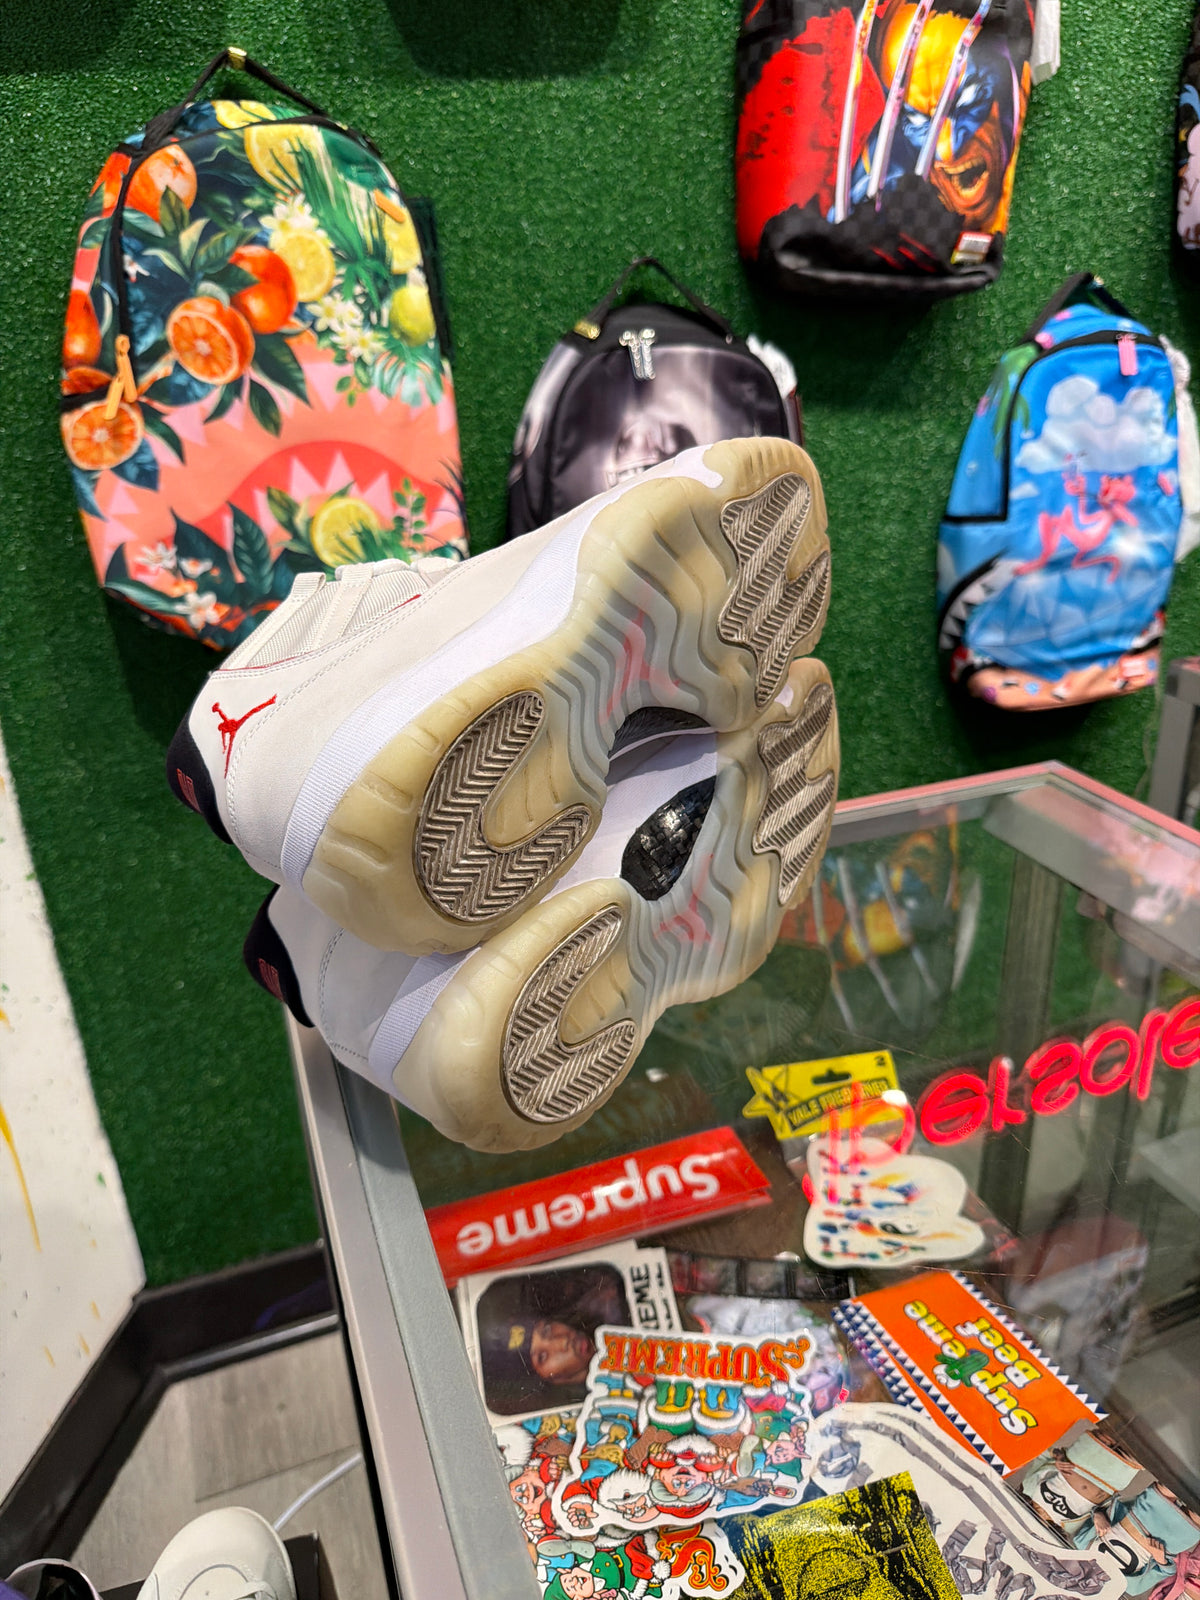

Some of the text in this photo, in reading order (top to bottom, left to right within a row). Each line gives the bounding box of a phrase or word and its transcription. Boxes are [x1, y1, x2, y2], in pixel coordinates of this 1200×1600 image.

[456, 1153, 720, 1256] Supreme
[599, 1333, 811, 1388] SUPREME
[903, 1299, 1039, 1436] Supeme
[954, 1316, 1043, 1389] Beef
